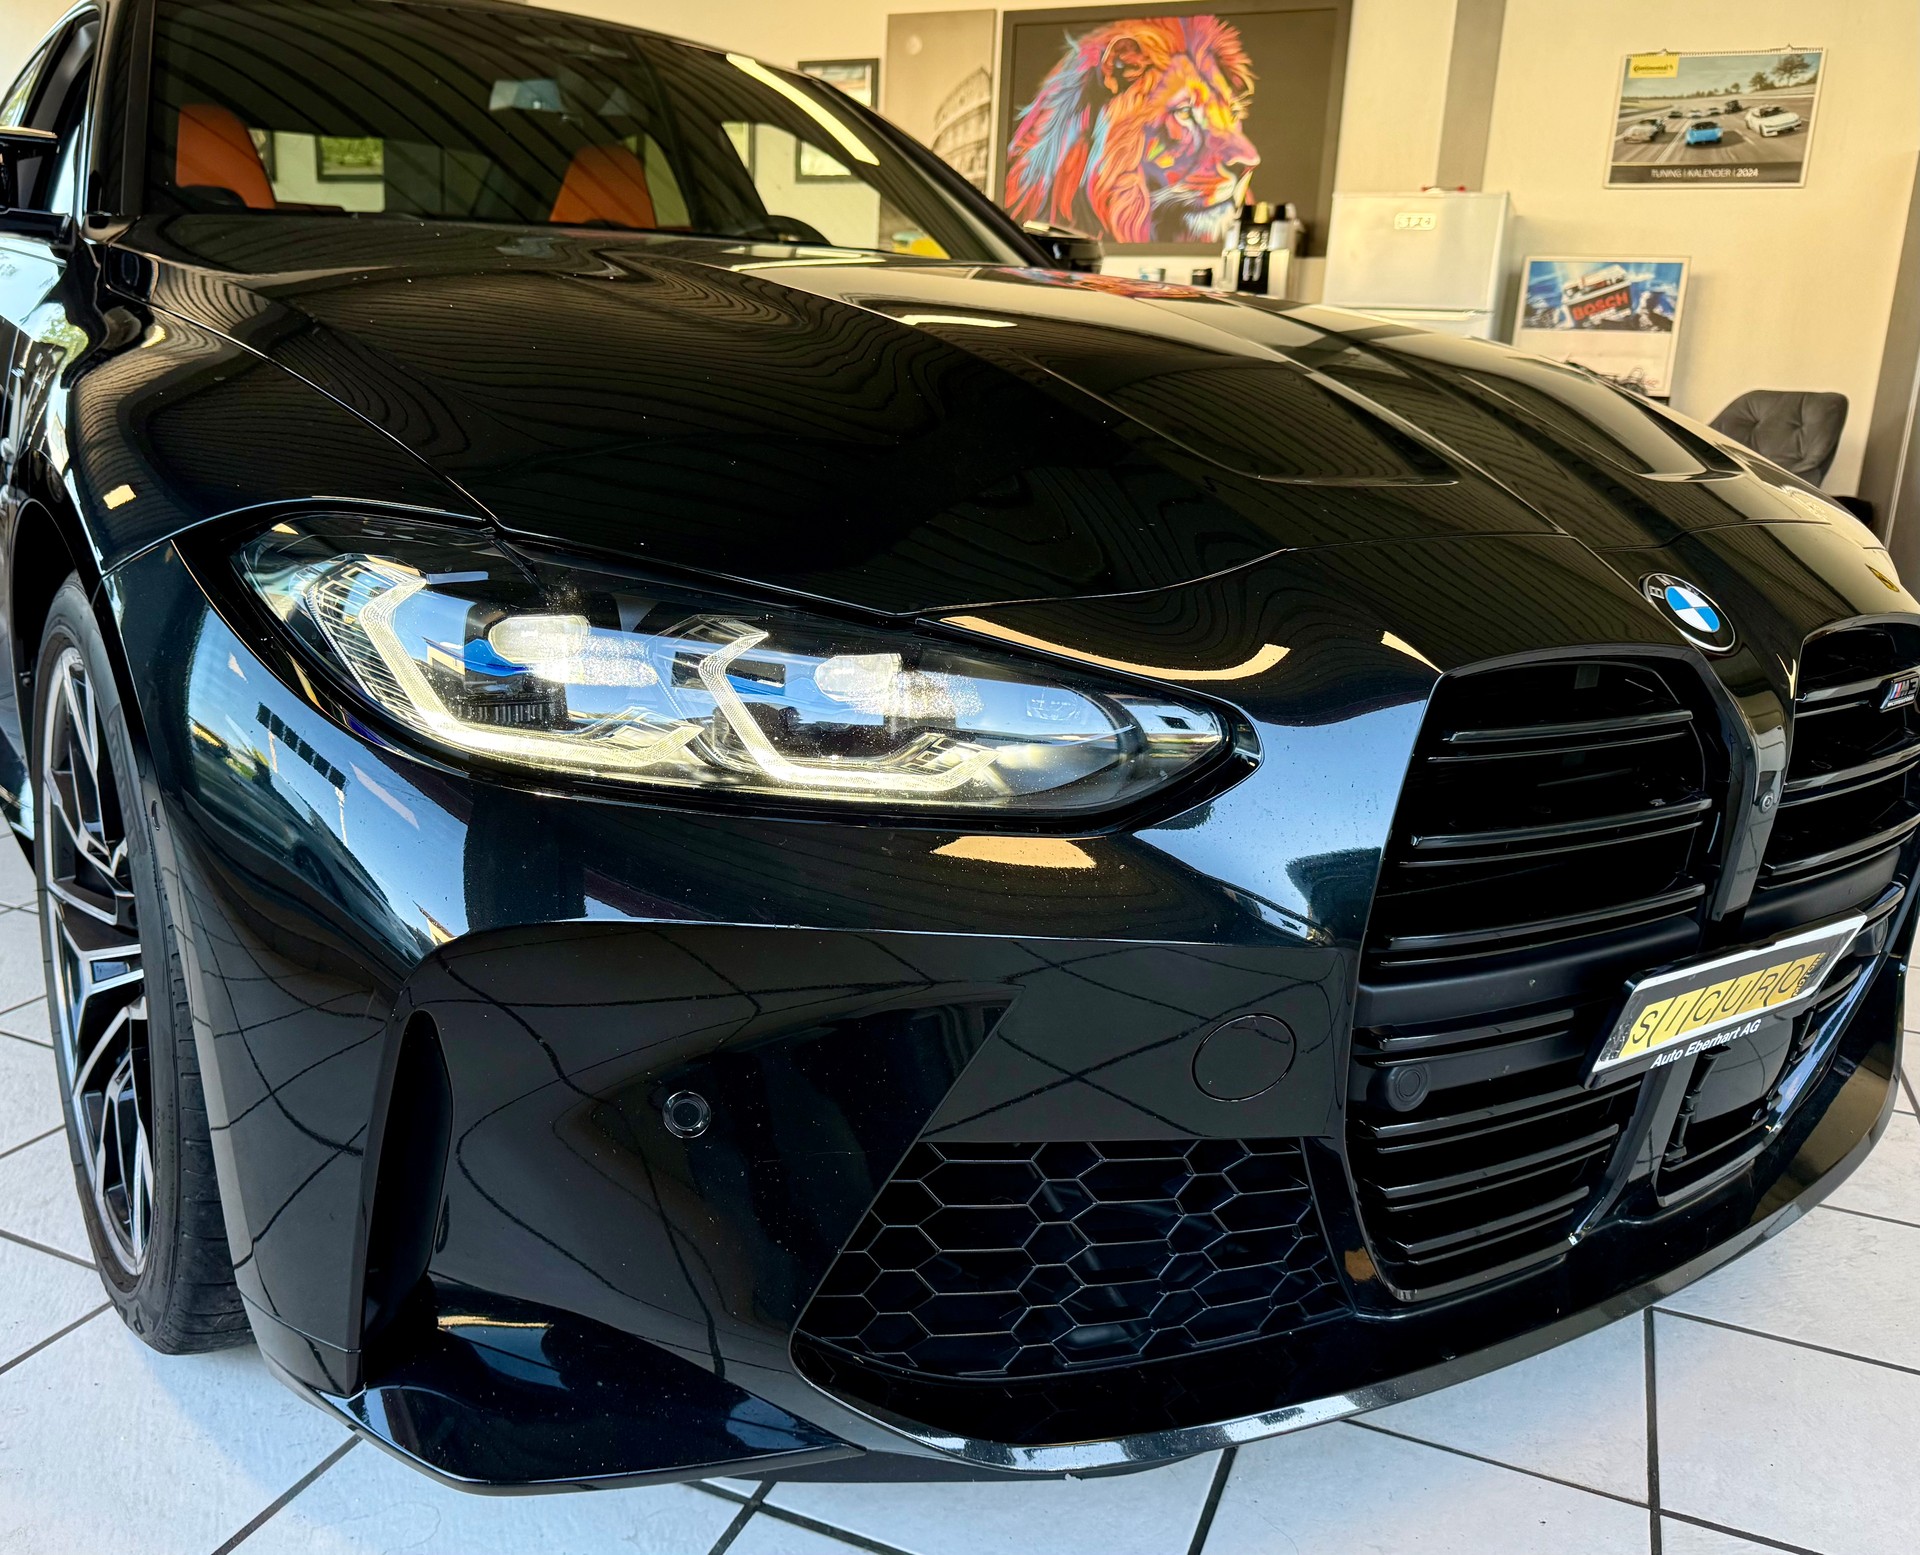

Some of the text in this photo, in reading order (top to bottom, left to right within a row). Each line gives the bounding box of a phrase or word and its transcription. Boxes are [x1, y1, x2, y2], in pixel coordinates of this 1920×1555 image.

[1650, 168, 1759, 178] TUNING KALENDER 2024
[1572, 291, 1629, 320] BOSCH
[1632, 963, 1807, 1045] SICURO
[1650, 1018, 1762, 1069] Auto Eberhart AG
